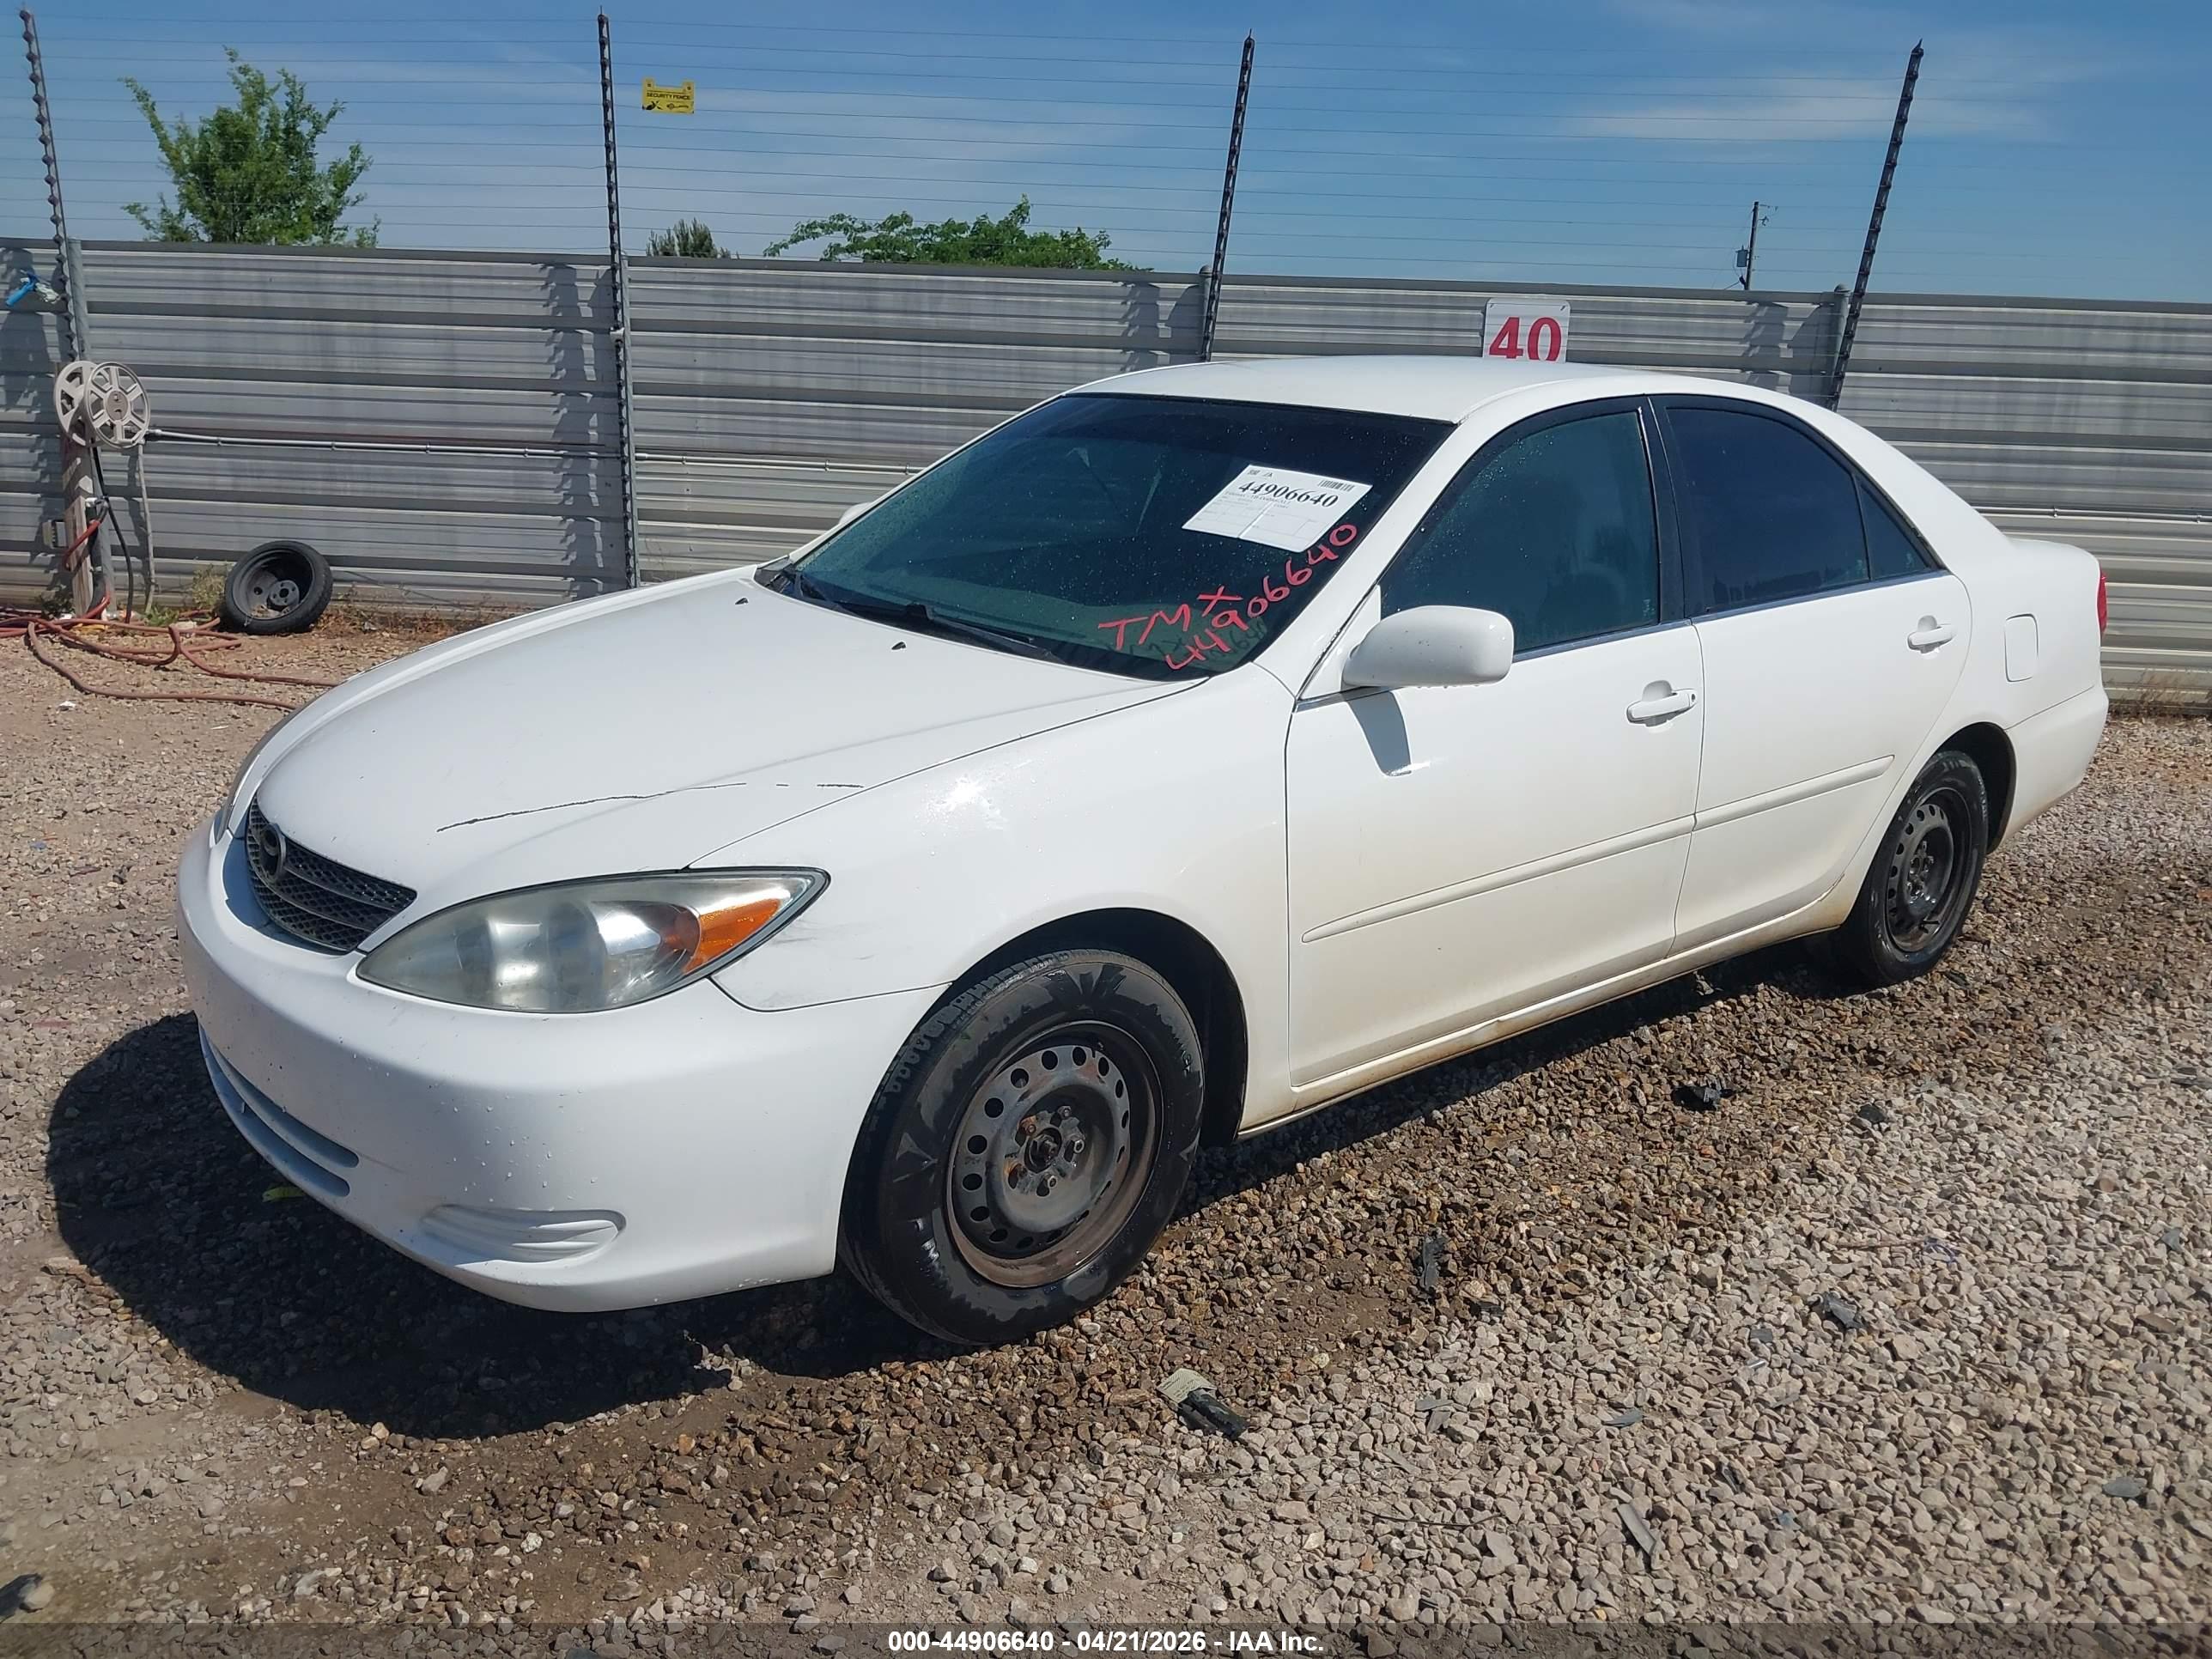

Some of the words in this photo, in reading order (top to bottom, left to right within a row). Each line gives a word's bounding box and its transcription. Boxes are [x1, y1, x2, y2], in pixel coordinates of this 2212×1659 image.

[1488, 316, 1562, 362] 40
[1237, 480, 1339, 507] 44906640
[1098, 586, 1243, 650] TMX
[1165, 524, 1357, 670] 44906640
